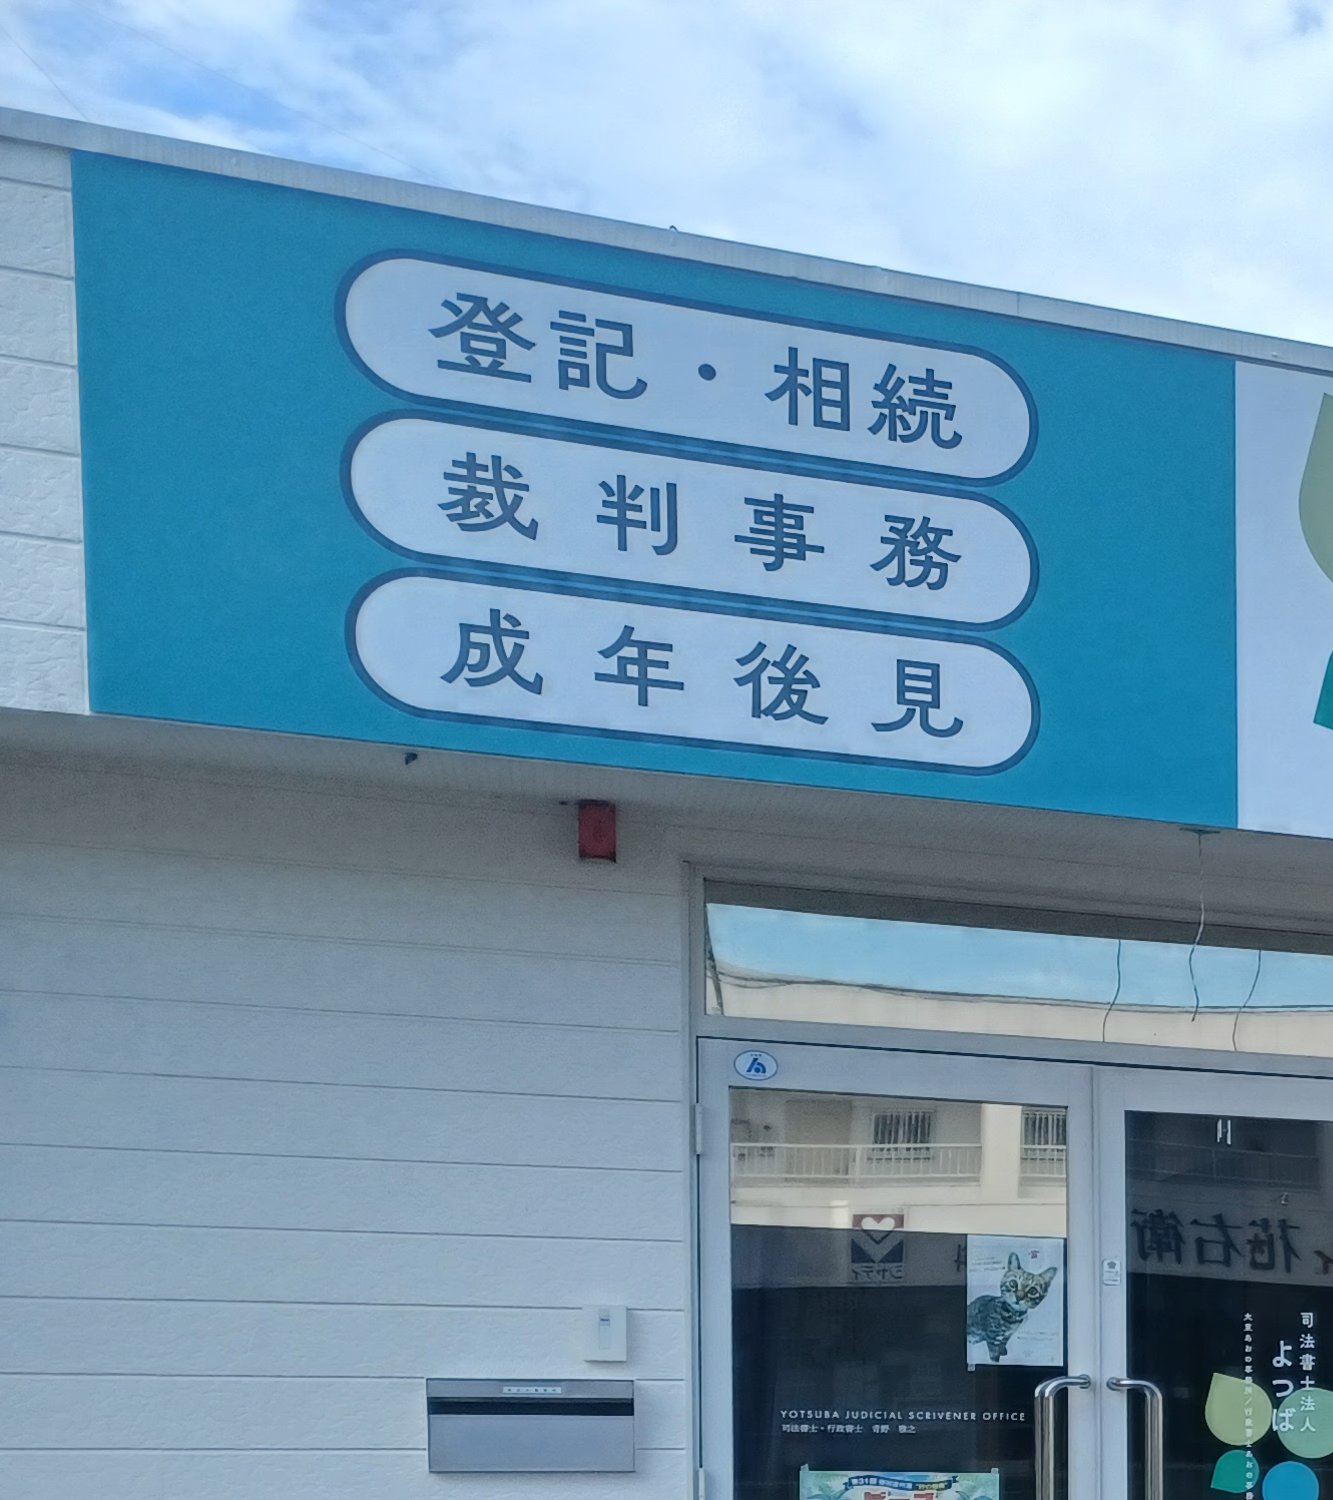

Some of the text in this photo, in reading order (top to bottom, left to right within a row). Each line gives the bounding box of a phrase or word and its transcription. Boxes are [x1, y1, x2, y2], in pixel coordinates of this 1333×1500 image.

[428, 291, 964, 450] 登記・相続
[436, 451, 962, 592] 裁判事務
[440, 611, 964, 740] 成年後見
[780, 1410, 1026, 1422] YOTSUBA JUDICIAL SCRIVENER OFFICE
[1272, 1340, 1296, 1432] よつば
[1300, 1312, 1316, 1432] 司法書士法人
